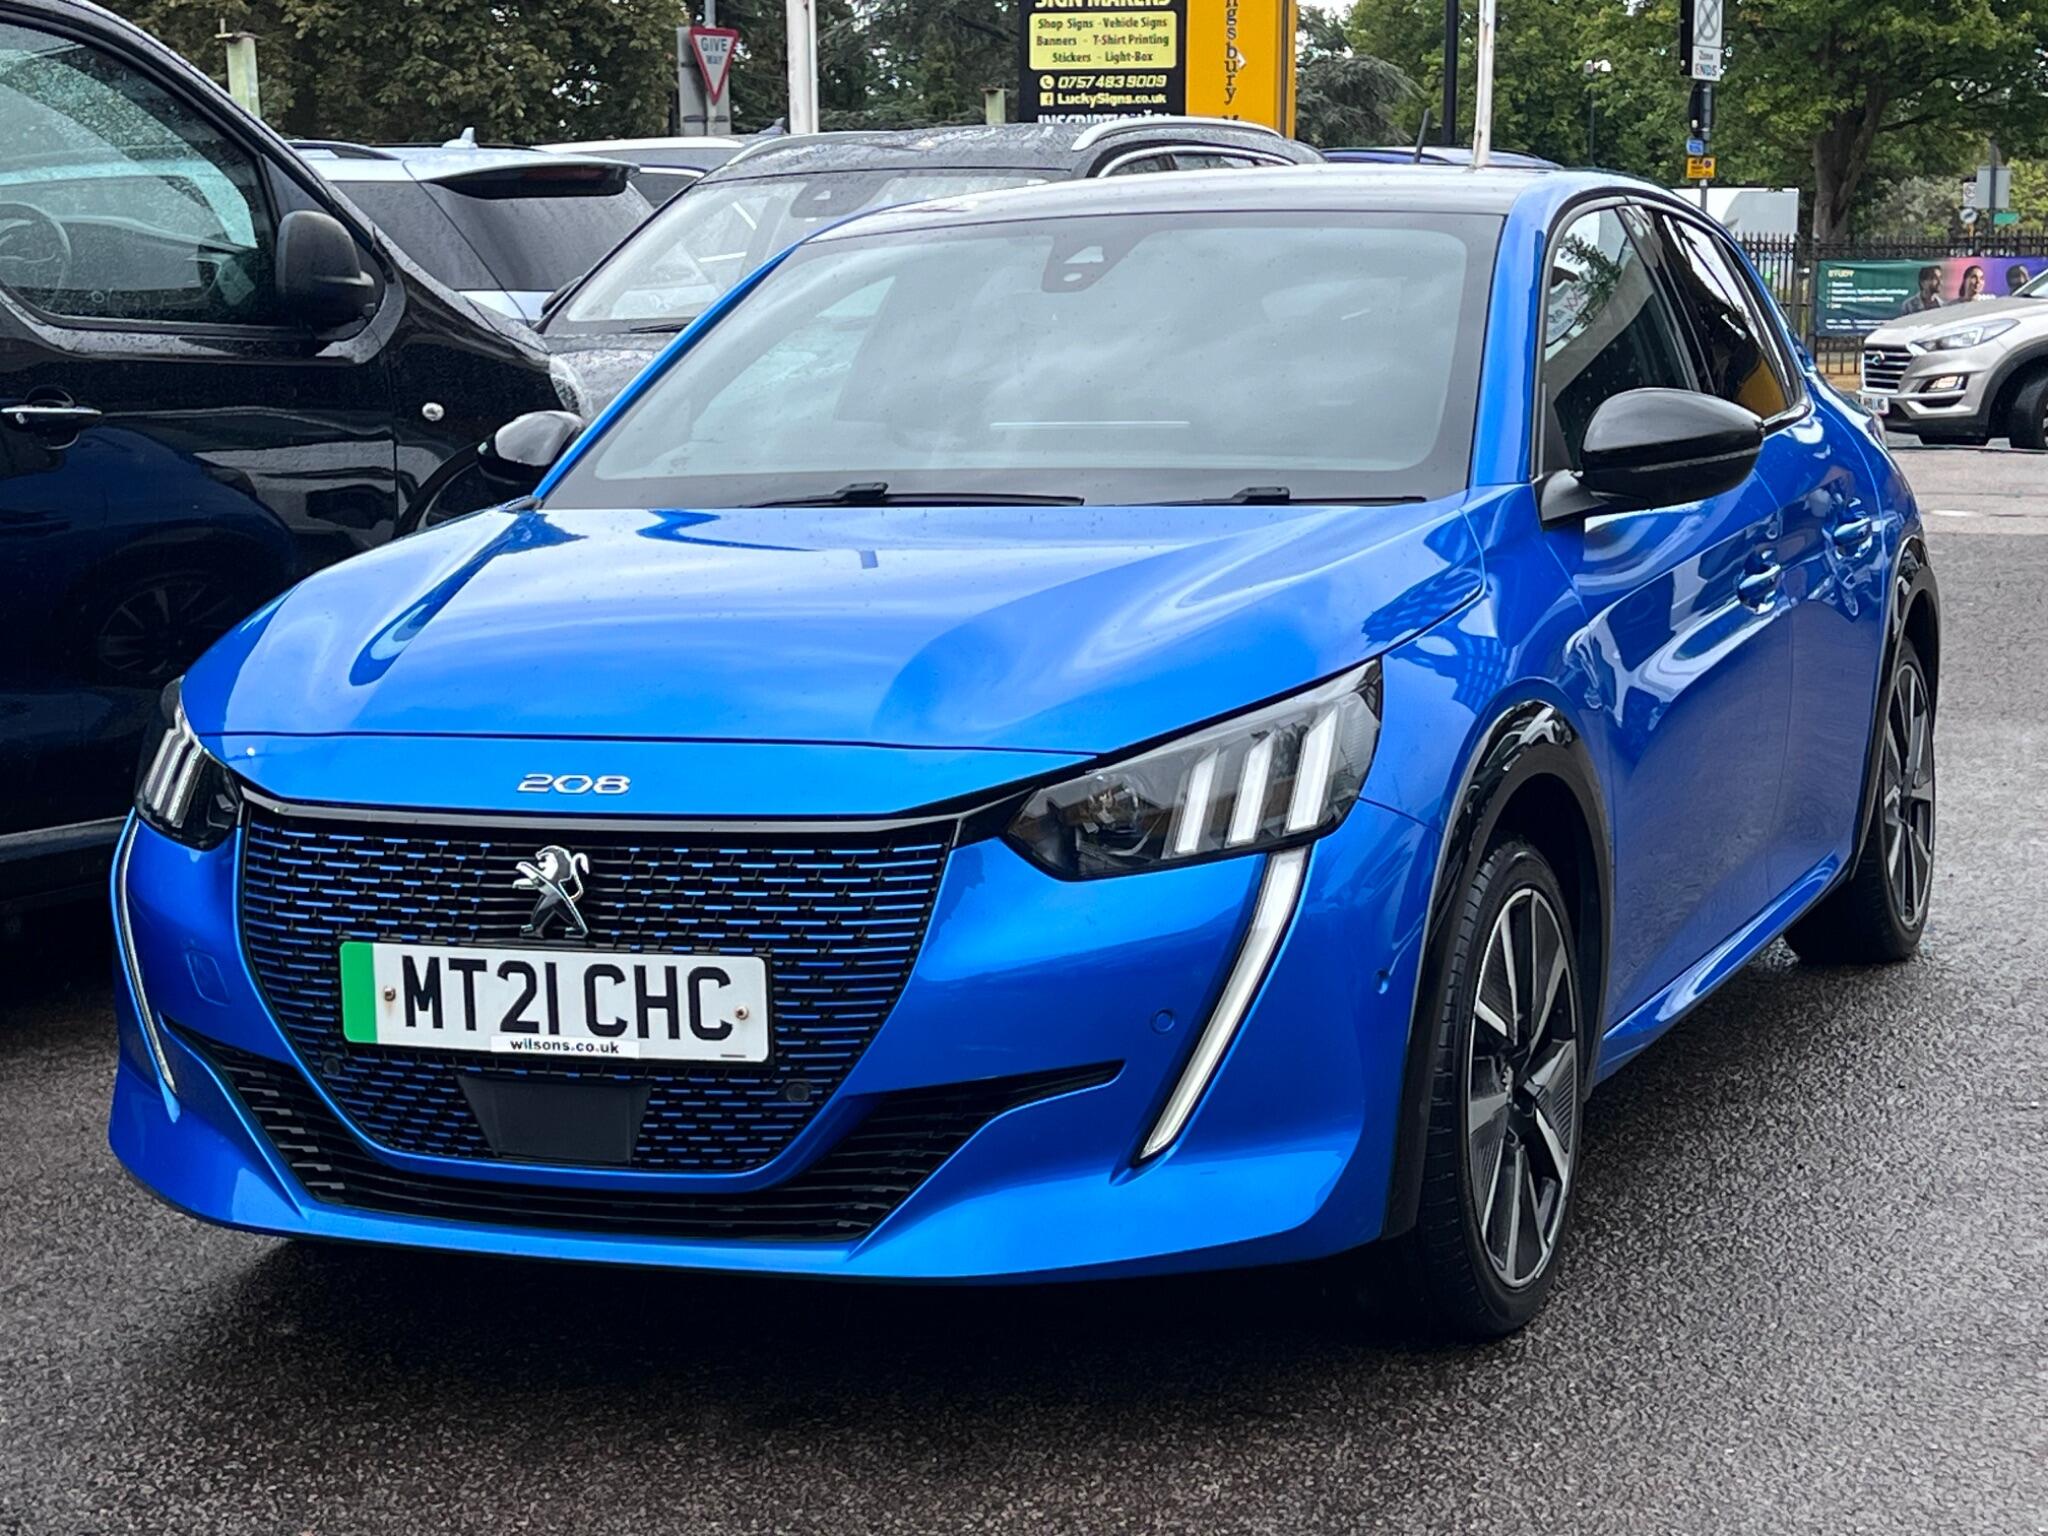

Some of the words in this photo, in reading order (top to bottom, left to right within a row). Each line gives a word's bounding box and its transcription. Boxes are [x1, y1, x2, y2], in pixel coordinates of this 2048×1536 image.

[1038, 18, 1063, 30] Shop
[1067, 18, 1093, 31] Signs
[1103, 17, 1138, 28] Vehicle
[1141, 17, 1167, 29] Signs
[701, 37, 728, 52] GIVE
[1037, 35, 1077, 46] Banners
[1093, 34, 1126, 45] T-Shirt
[1128, 34, 1169, 47] Printing
[1052, 52, 1091, 63] Stickers
[1105, 50, 1153, 62] Light-Box
[1058, 92, 1167, 108] LuckySigns.co.uk
[517, 773, 631, 795] 208
[401, 954, 560, 1035] MT21
[583, 963, 733, 1041] CHC
[510, 1037, 620, 1054] wilsons.co.uk
